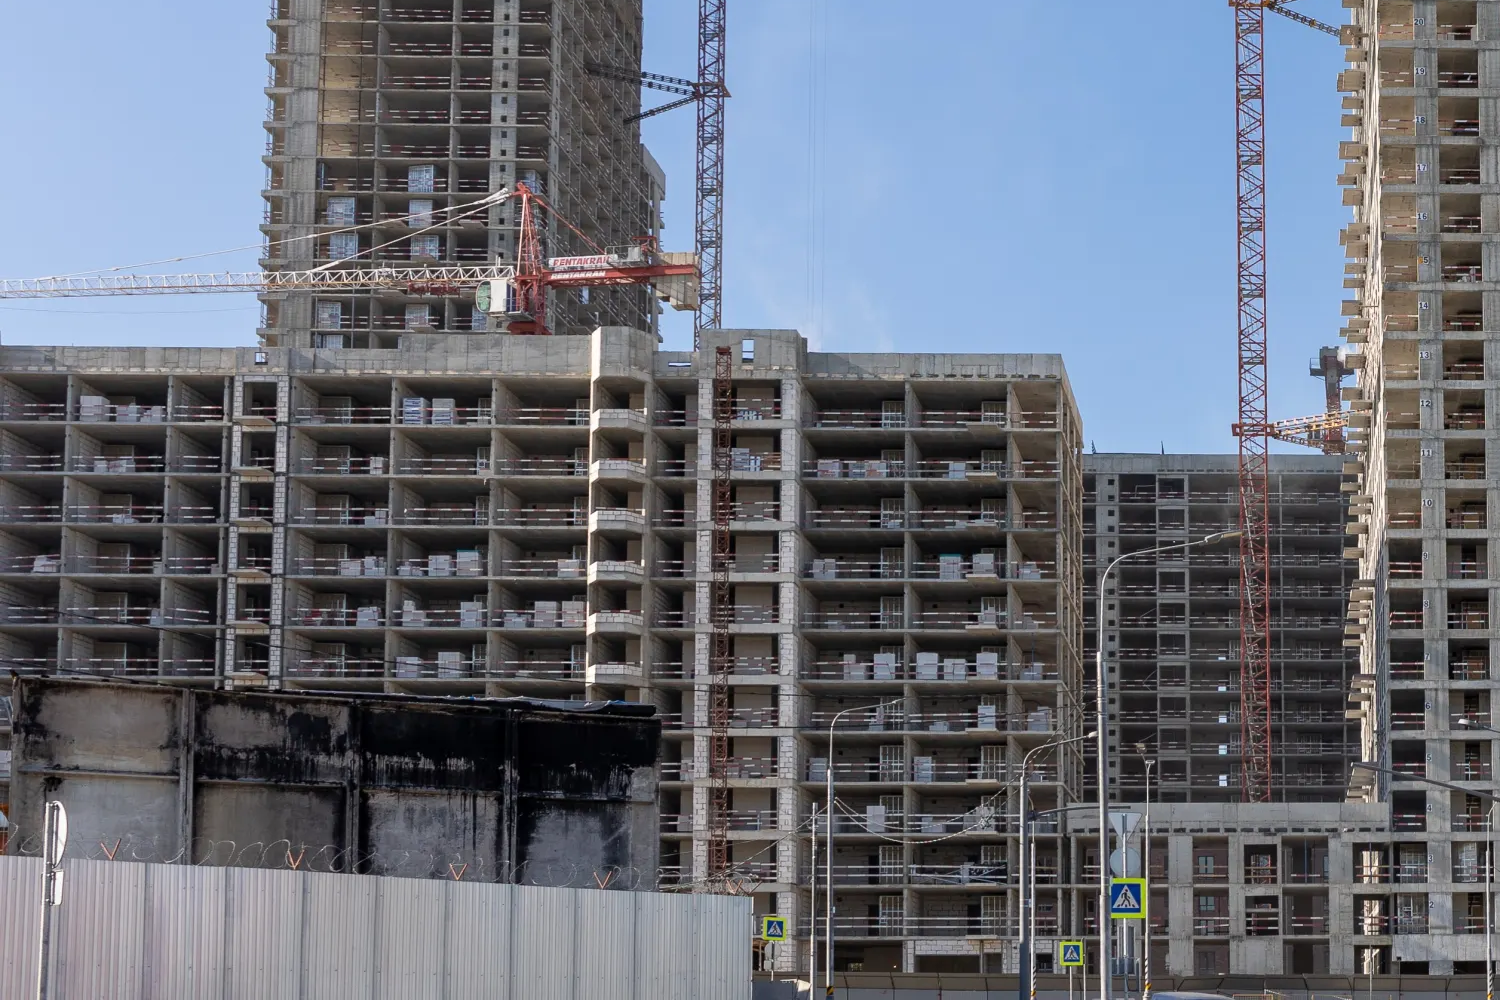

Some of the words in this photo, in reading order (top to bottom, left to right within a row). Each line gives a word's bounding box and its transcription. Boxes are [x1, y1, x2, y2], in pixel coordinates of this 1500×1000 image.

[1414, 18, 1424, 26] 20
[1415, 67, 1425, 75] 19
[1415, 116, 1425, 124] 18
[1417, 212, 1427, 220] 16
[1419, 301, 1428, 309] 14
[1419, 351, 1429, 359] 13
[1421, 449, 1431, 457] 11
[1422, 499, 1432, 507] 10
